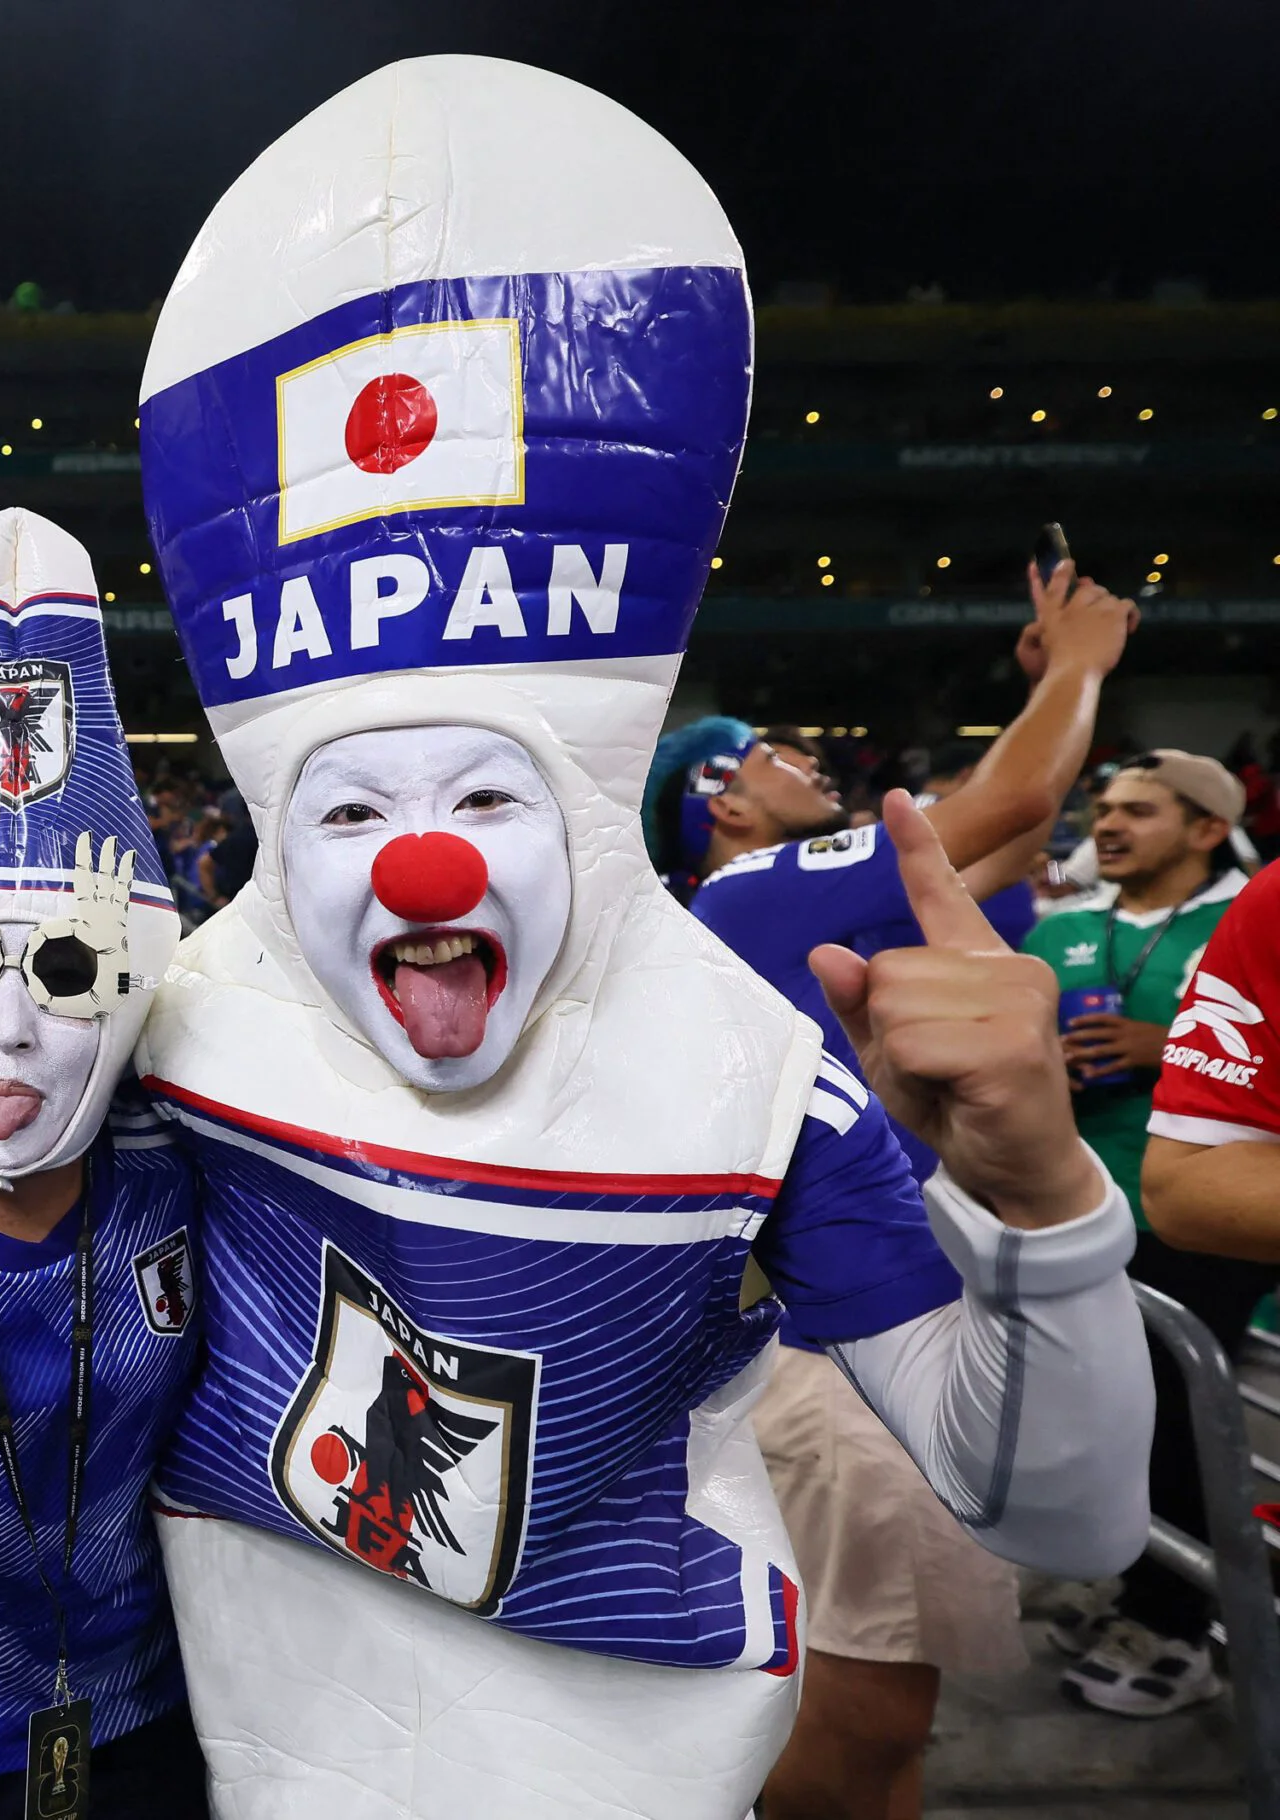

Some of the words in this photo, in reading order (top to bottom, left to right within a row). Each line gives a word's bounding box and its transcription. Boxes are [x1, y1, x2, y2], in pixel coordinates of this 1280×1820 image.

[222, 543, 629, 680] JAPAN
[148, 1240, 177, 1262] JAPAN
[368, 1290, 460, 1382] JAPAN
[320, 1497, 432, 1589] JFA
